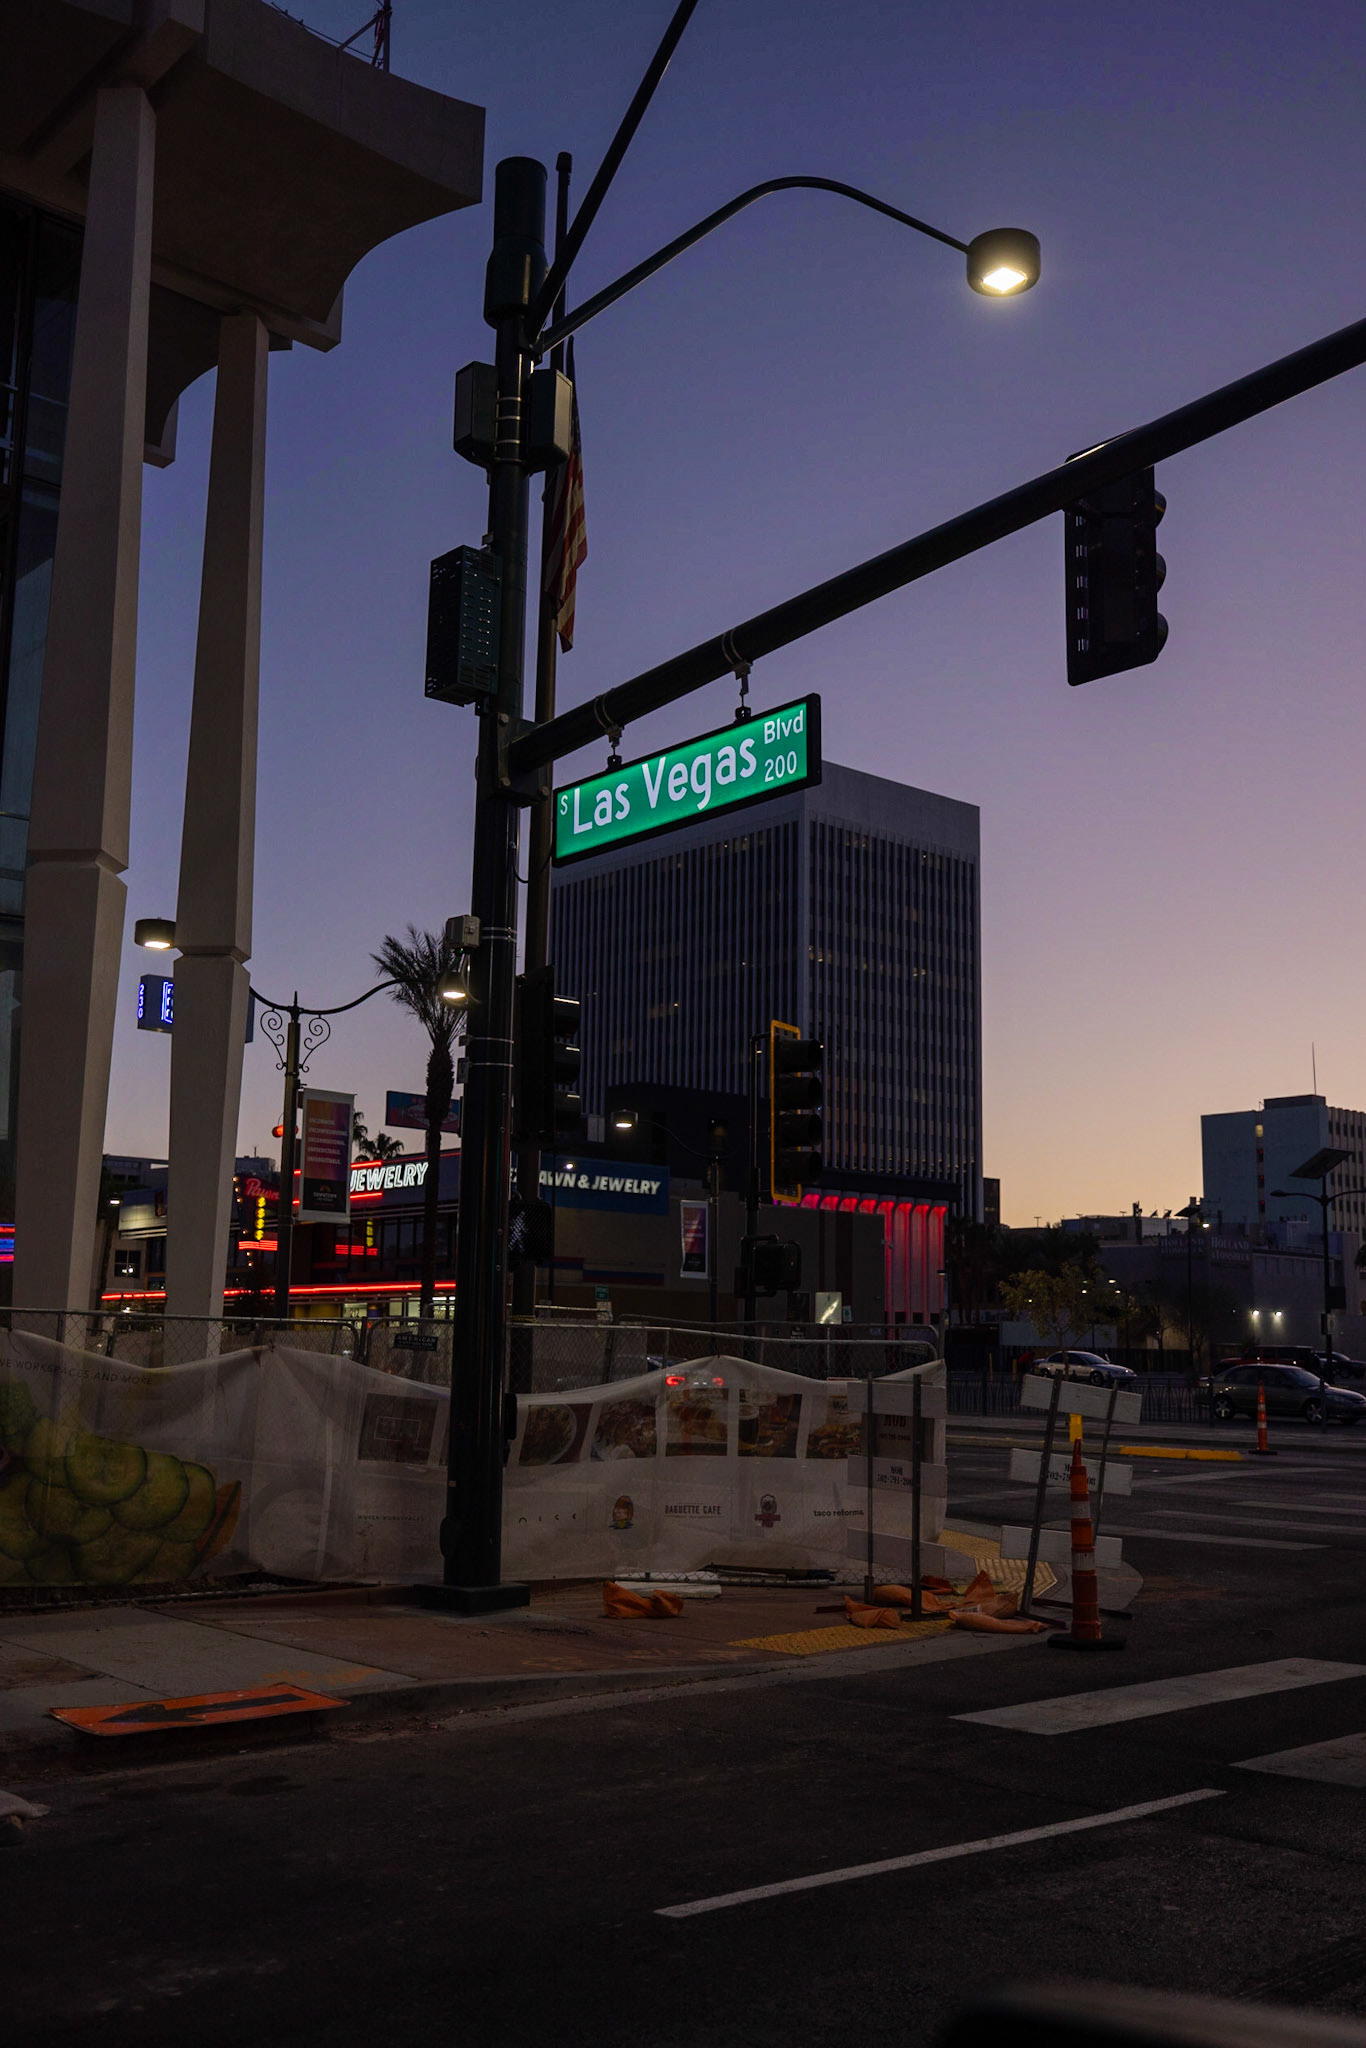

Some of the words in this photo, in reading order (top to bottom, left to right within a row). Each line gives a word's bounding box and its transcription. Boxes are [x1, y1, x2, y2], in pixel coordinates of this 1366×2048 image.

[560, 794, 568, 816] S
[573, 783, 631, 835] Las
[642, 738, 757, 810] Vegas
[764, 709, 804, 744] Blvd
[764, 751, 798, 783] 200
[350, 1161, 429, 1192] JEWELRY
[577, 1173, 591, 1190] &
[592, 1175, 661, 1196] JEWELRY
[16, 1360, 89, 1379] WORKSPACES
[94, 1372, 118, 1382] AND
[122, 1375, 152, 1385] MORE
